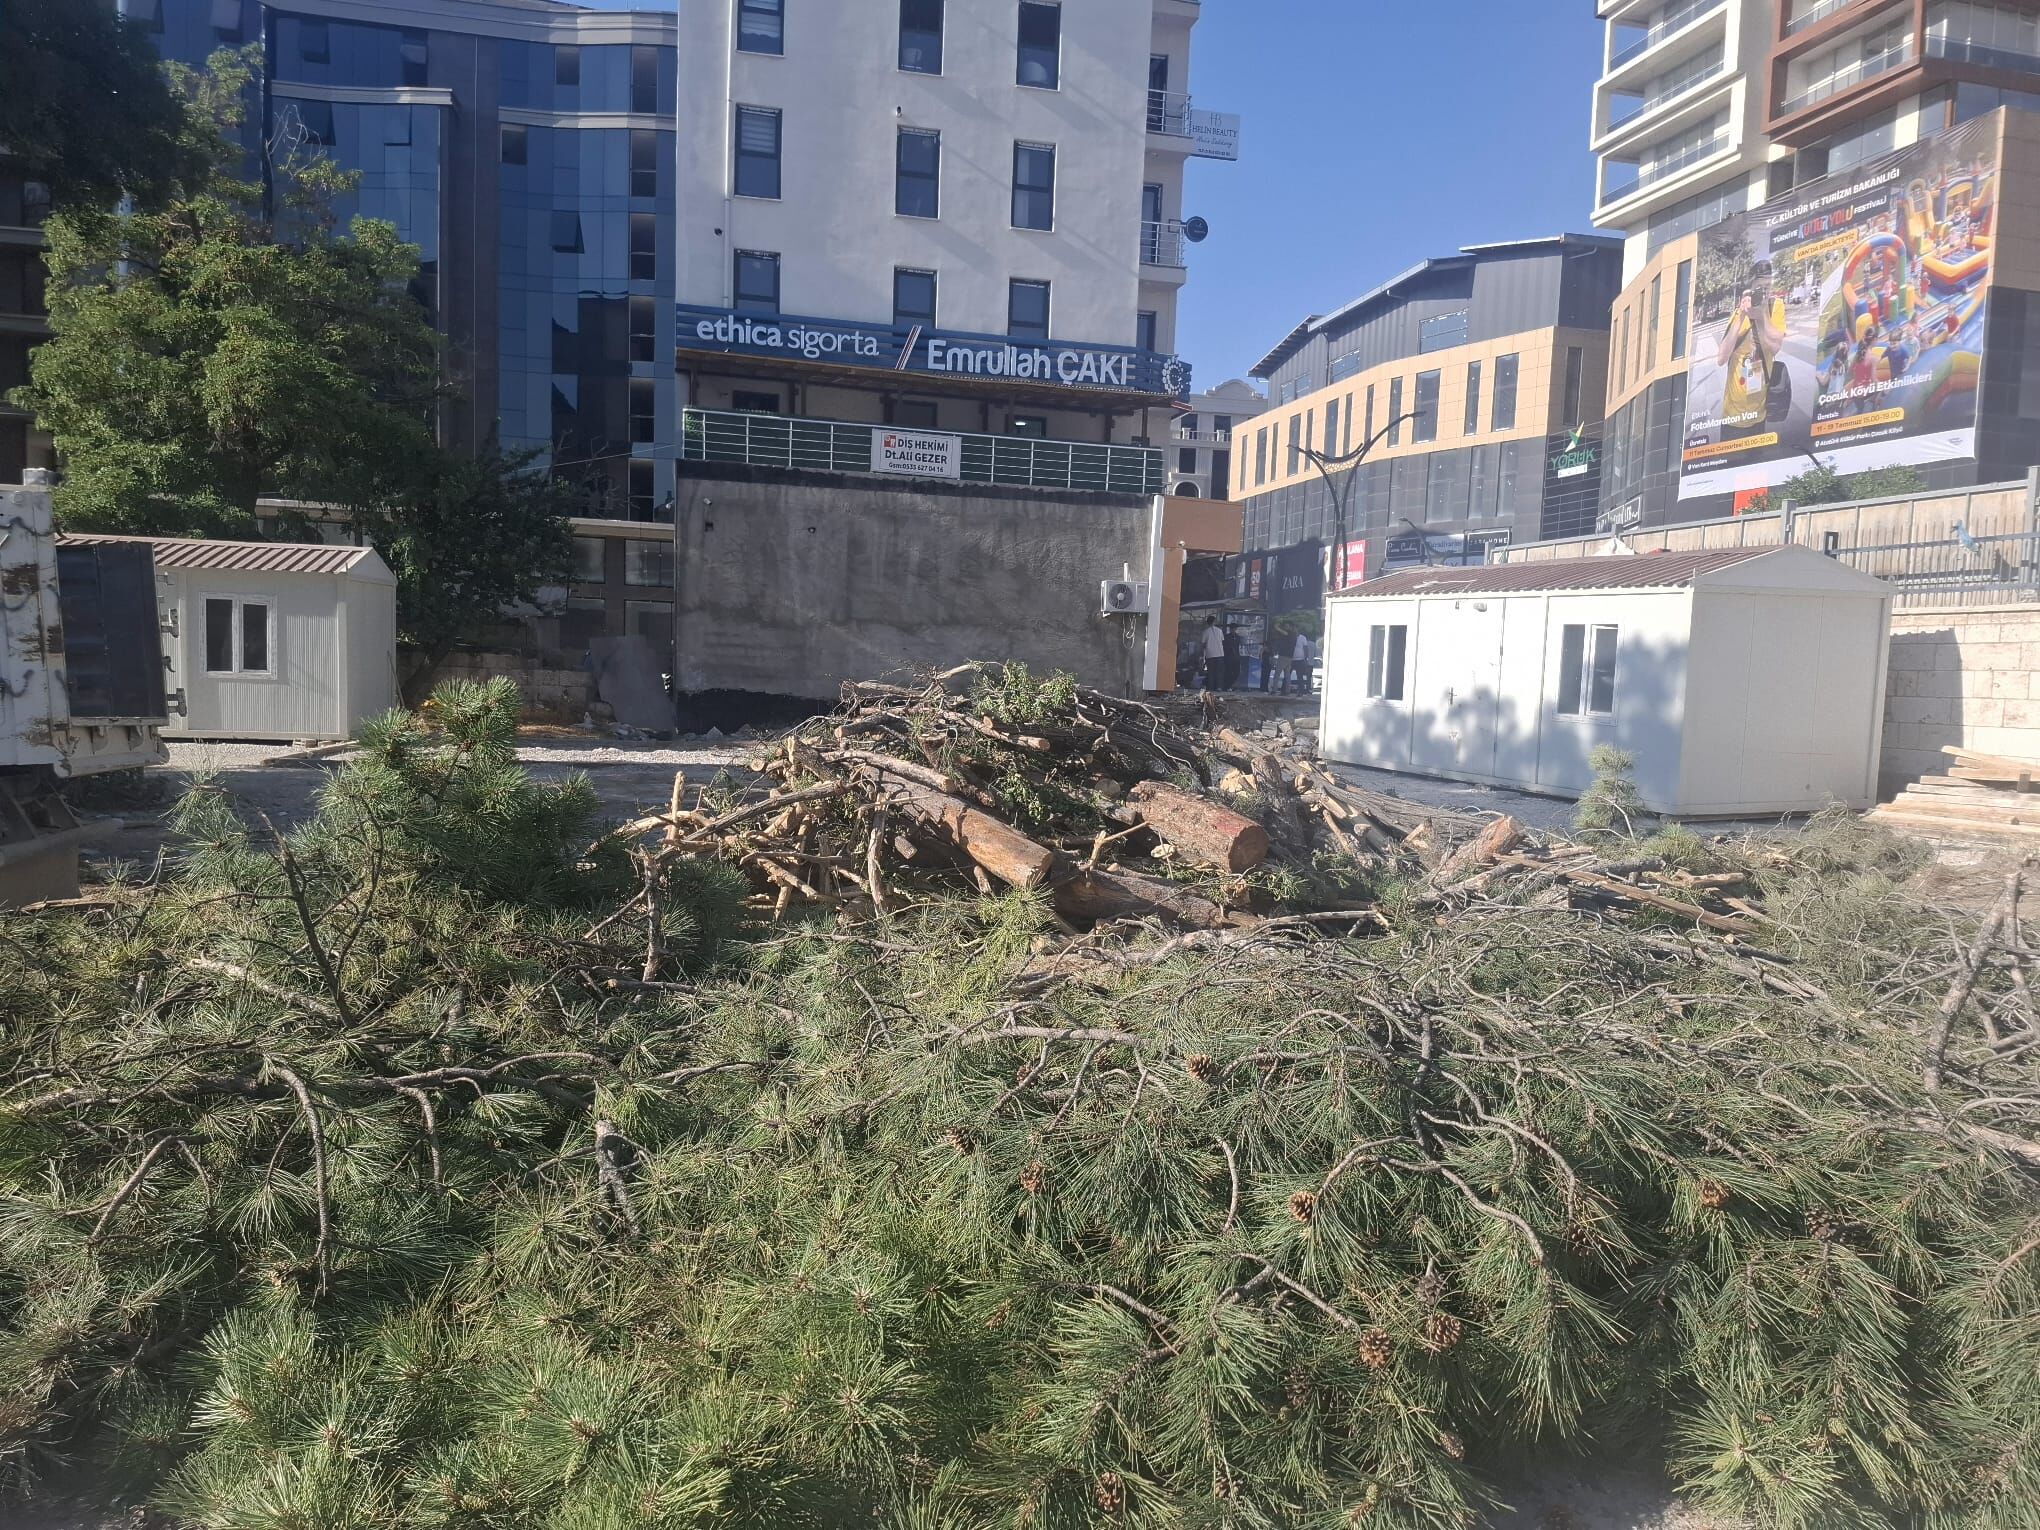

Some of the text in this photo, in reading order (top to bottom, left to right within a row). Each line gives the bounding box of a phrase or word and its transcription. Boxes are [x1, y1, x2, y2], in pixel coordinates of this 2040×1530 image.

[1213, 128, 1237, 137] BEAUTY
[1779, 204, 1809, 222] KÜLTÜR
[1810, 201, 1820, 211] VE
[1821, 186, 1852, 206] TURİZM
[1853, 168, 1900, 194] BAKANLIĞI
[697, 315, 880, 359] ethica sigorta
[928, 340, 1051, 380] Emrullah
[1819, 370, 1933, 406] Çocuk Köyü Etkinlikleri
[1690, 411, 1758, 431] FotoMaraton Van
[1835, 419, 1862, 429] Temmuz
[897, 437, 949, 452] DİŞ HEKİMİ
[885, 450, 948, 464] Dt.Ali GEZER
[1282, 575, 1304, 590] ZARA
